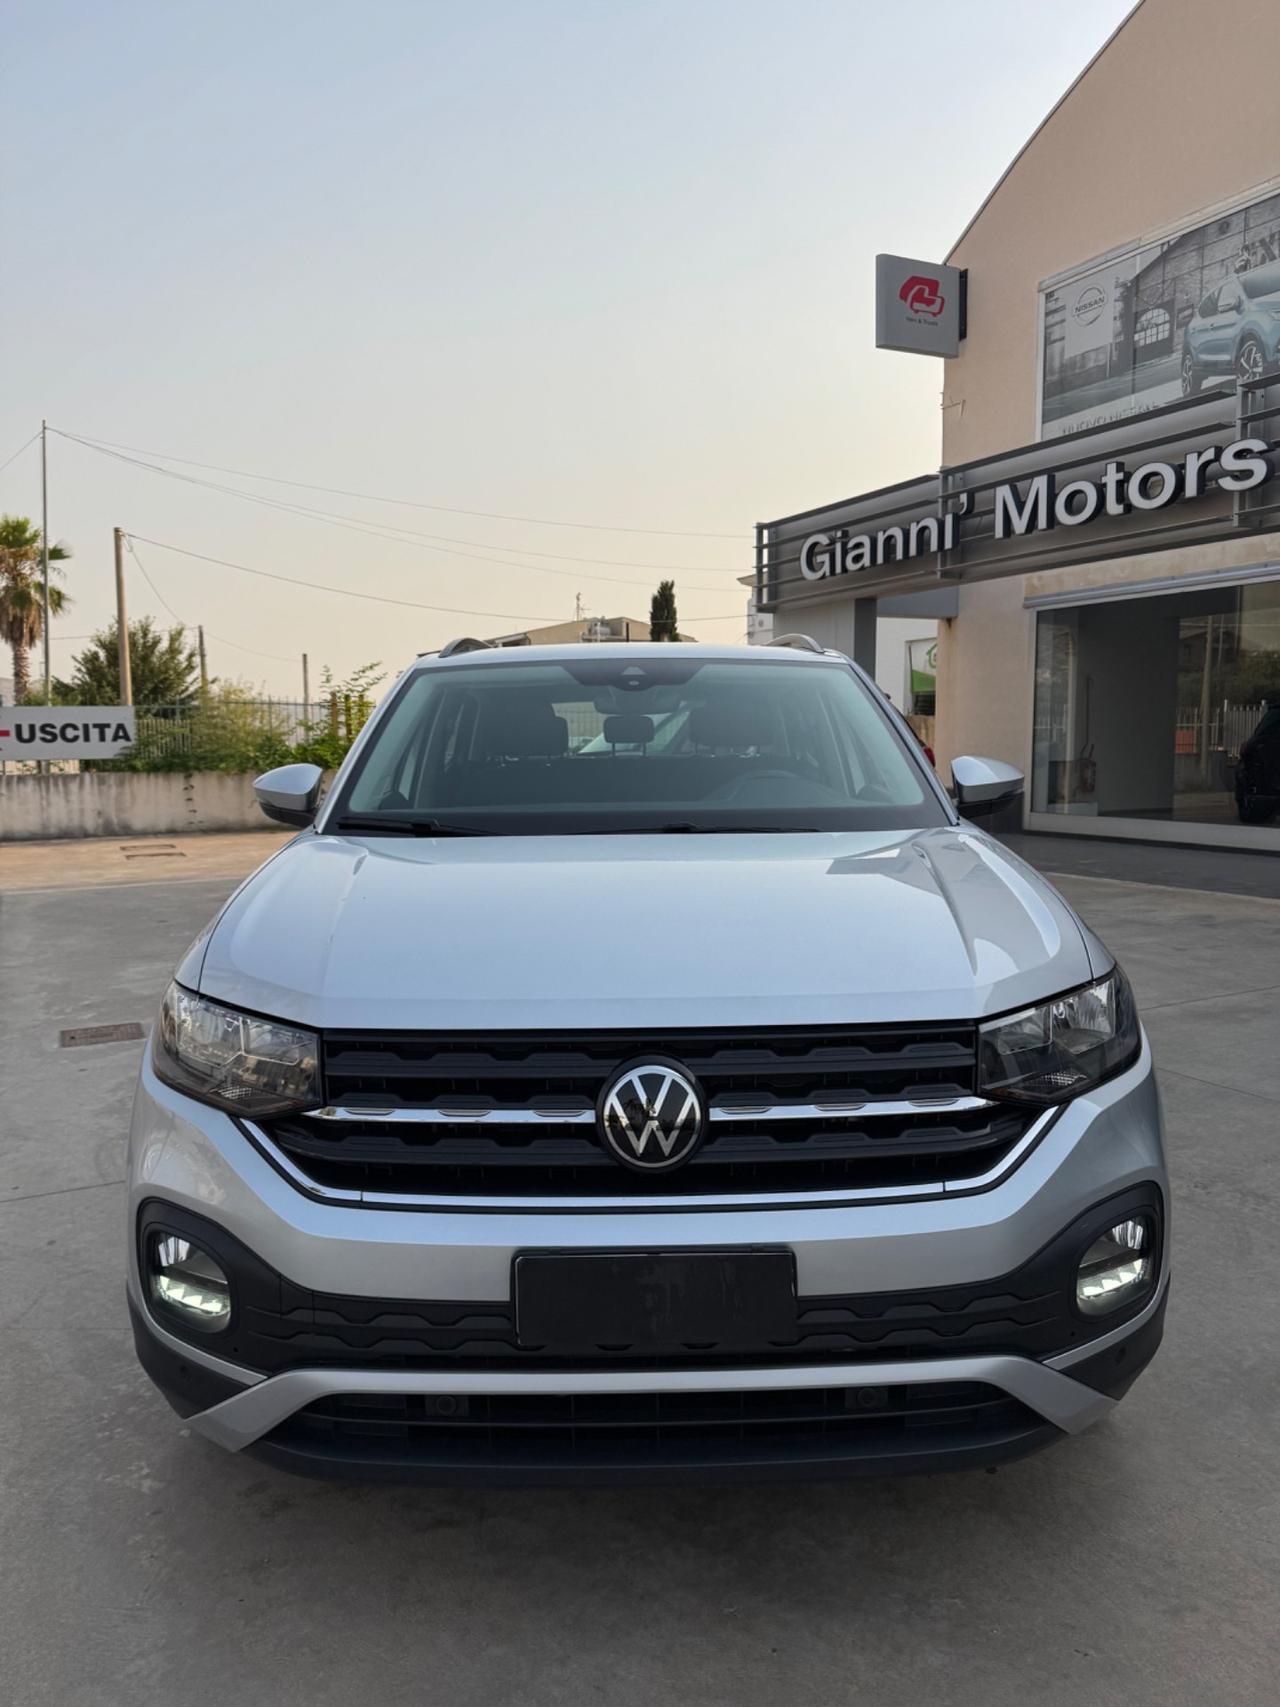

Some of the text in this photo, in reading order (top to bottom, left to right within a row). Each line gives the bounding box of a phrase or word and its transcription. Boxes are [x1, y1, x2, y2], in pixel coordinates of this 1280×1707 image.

[1074, 295, 1105, 313] NISSAN
[994, 437, 1274, 540] Motors
[14, 722, 132, 744] USCITA
